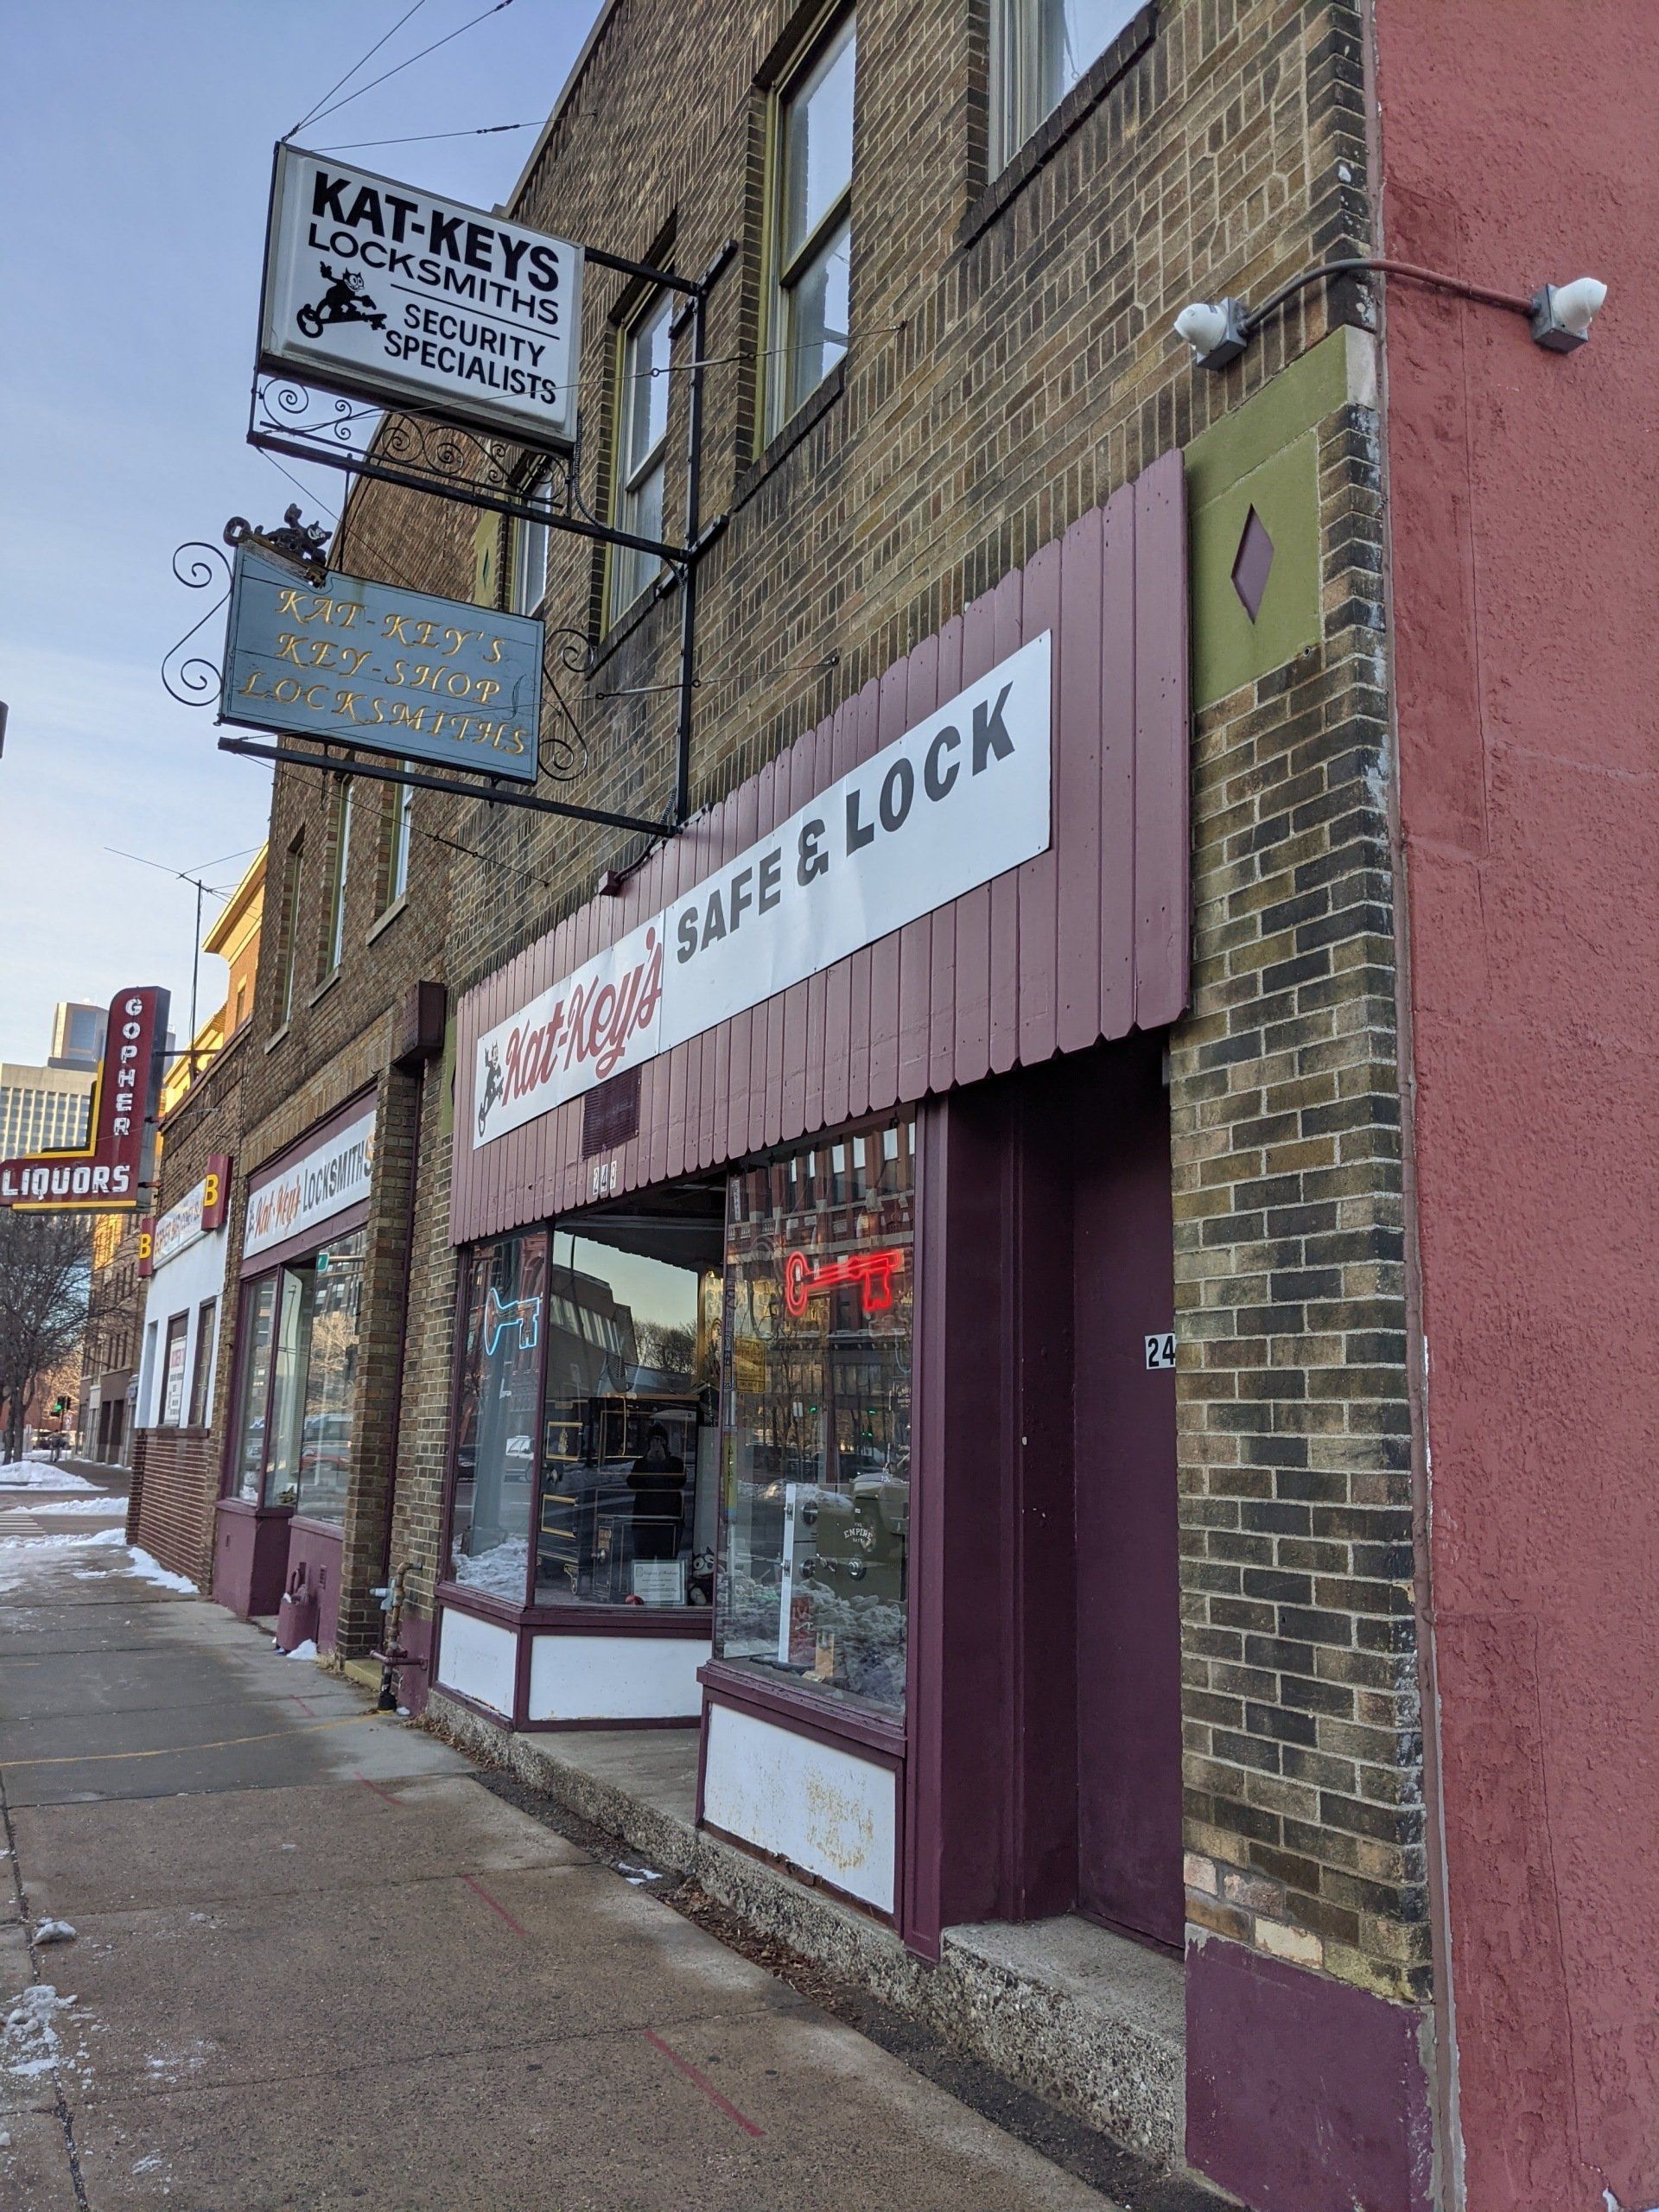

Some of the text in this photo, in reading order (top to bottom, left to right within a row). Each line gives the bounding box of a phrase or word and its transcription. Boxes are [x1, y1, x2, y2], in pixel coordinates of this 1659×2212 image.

[312, 170, 559, 292] KAT-KEYS
[308, 222, 559, 325] LOCKSMITHS
[384, 330, 556, 404] SPECIALISTS
[404, 303, 545, 367] SECURITY
[275, 588, 505, 664] KAT-KEY'S
[274, 632, 500, 703] KEY-SHOP
[238, 671, 528, 756] LOCKSMITHS
[501, 681, 1015, 1107] Kat-Key's SAFE & LOCK
[113, 998, 143, 1136] GOPHER
[2, 1166, 130, 1199] LIQUORS
[204, 1173, 219, 1206] B
[302, 1134, 375, 1213] LOCKSMITHS
[139, 1233, 151, 1259] B
[843, 1528, 873, 1539] EMPIRE
